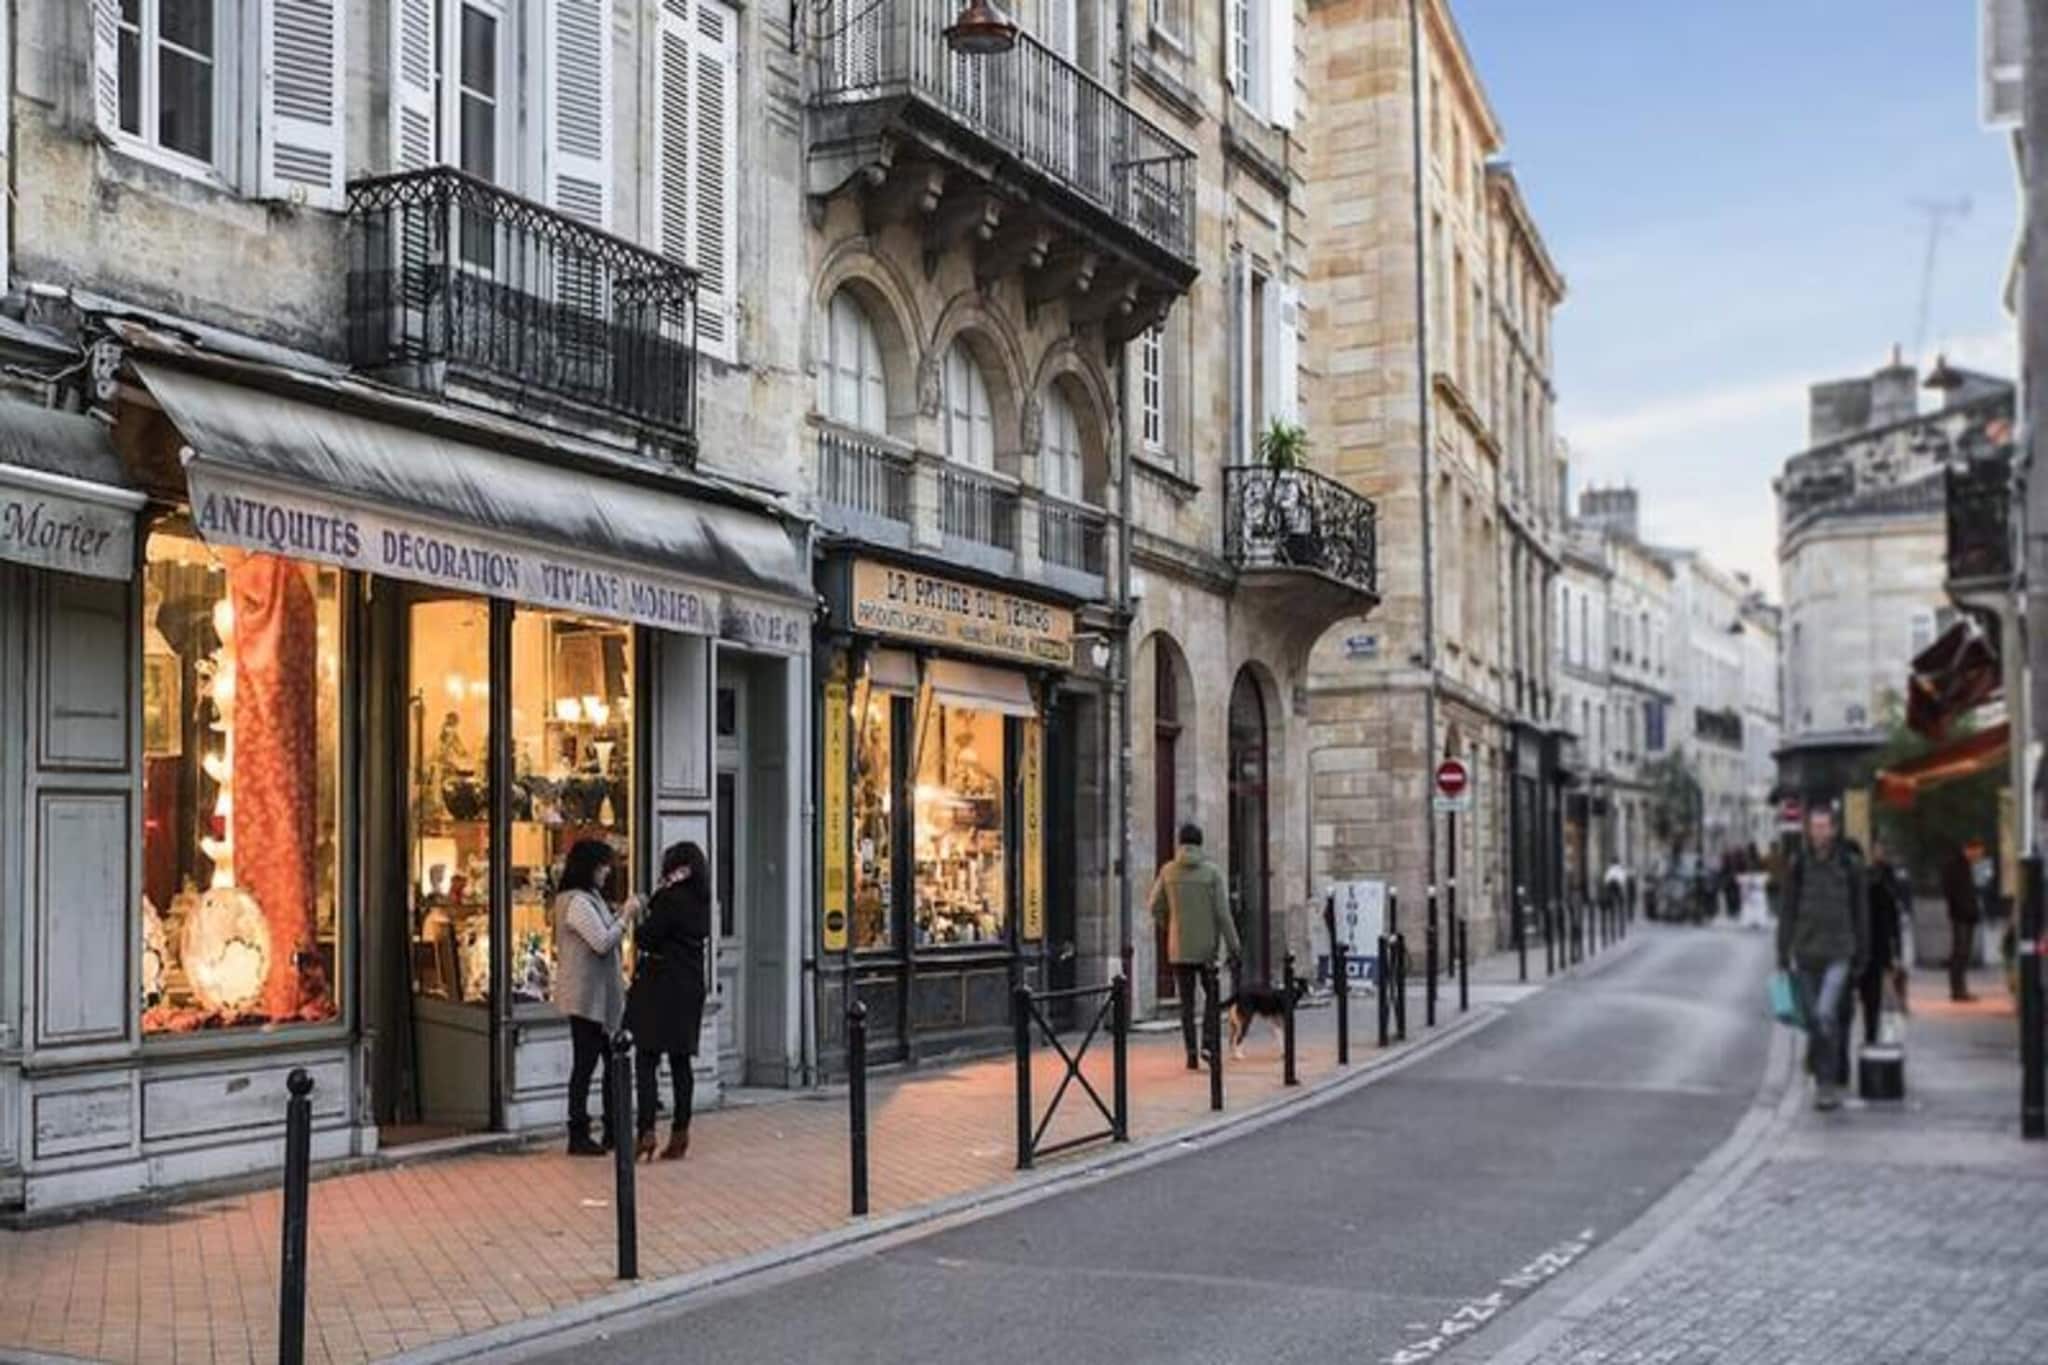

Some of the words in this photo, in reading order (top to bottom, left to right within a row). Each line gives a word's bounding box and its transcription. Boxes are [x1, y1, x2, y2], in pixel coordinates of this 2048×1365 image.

[3, 502, 112, 557] Morier
[543, 563, 618, 612] VIVIANE
[631, 584, 699, 623] MORIER
[1026, 730, 1042, 924] ANTIQUES
